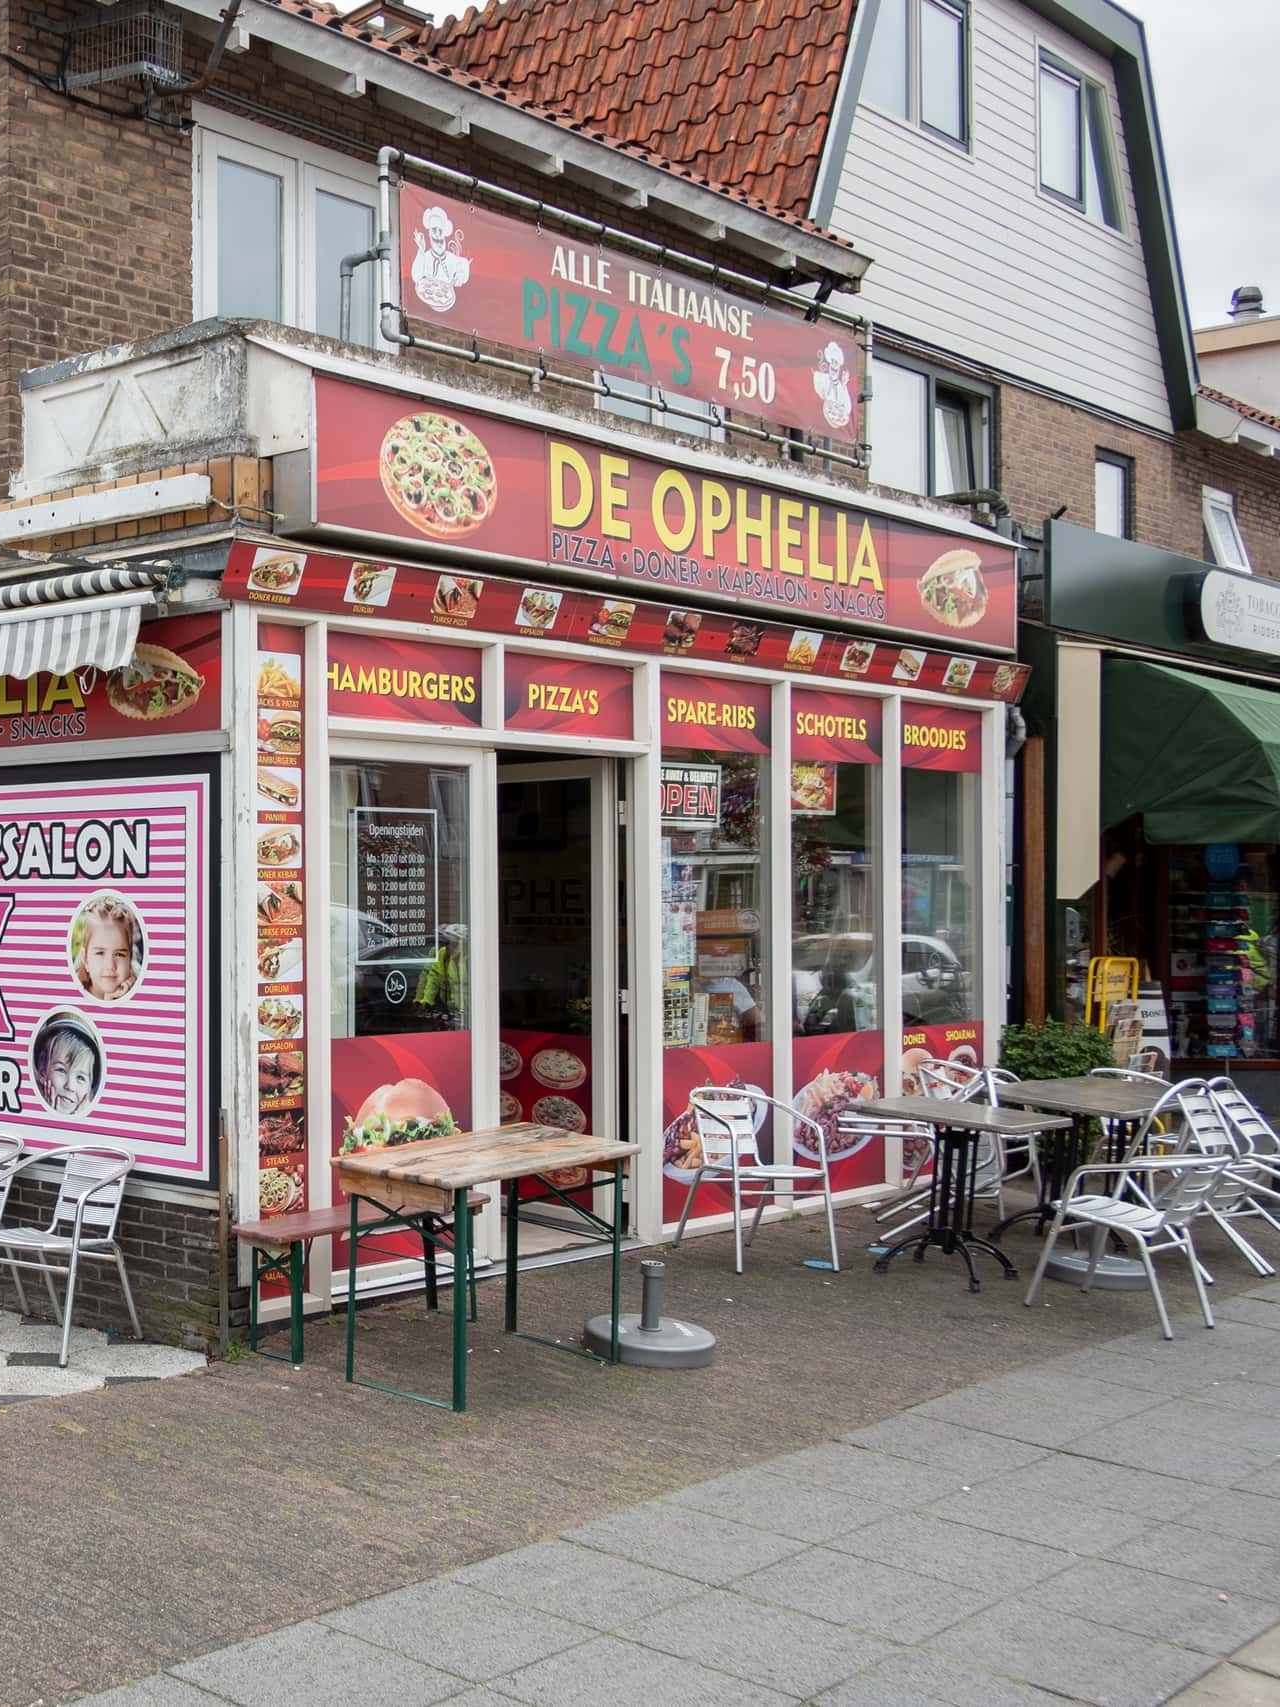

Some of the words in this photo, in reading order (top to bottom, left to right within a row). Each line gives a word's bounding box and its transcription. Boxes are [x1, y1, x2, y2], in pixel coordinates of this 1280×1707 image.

[550, 244, 612, 296] ALLE
[627, 268, 754, 342] ITALIAANSE
[522, 277, 693, 387] PIZZA'S
[713, 346, 776, 406] 7,50
[549, 442, 632, 542] DE
[651, 468, 886, 593] OPHELIA
[550, 531, 617, 571] PIZZA
[631, 548, 701, 587] DONER
[717, 564, 809, 608] KAPSALON
[822, 587, 886, 622] SNACKS
[528, 683, 600, 716] PIZZA'S
[667, 697, 756, 730] SPARE-RIBS
[10, 712, 87, 740] SNACKS
[796, 712, 867, 741] SCHOTELS
[903, 724, 967, 751] BROODJES
[369, 823, 424, 838] Openingstijden
[260, 1041, 294, 1051] KAPSALON
